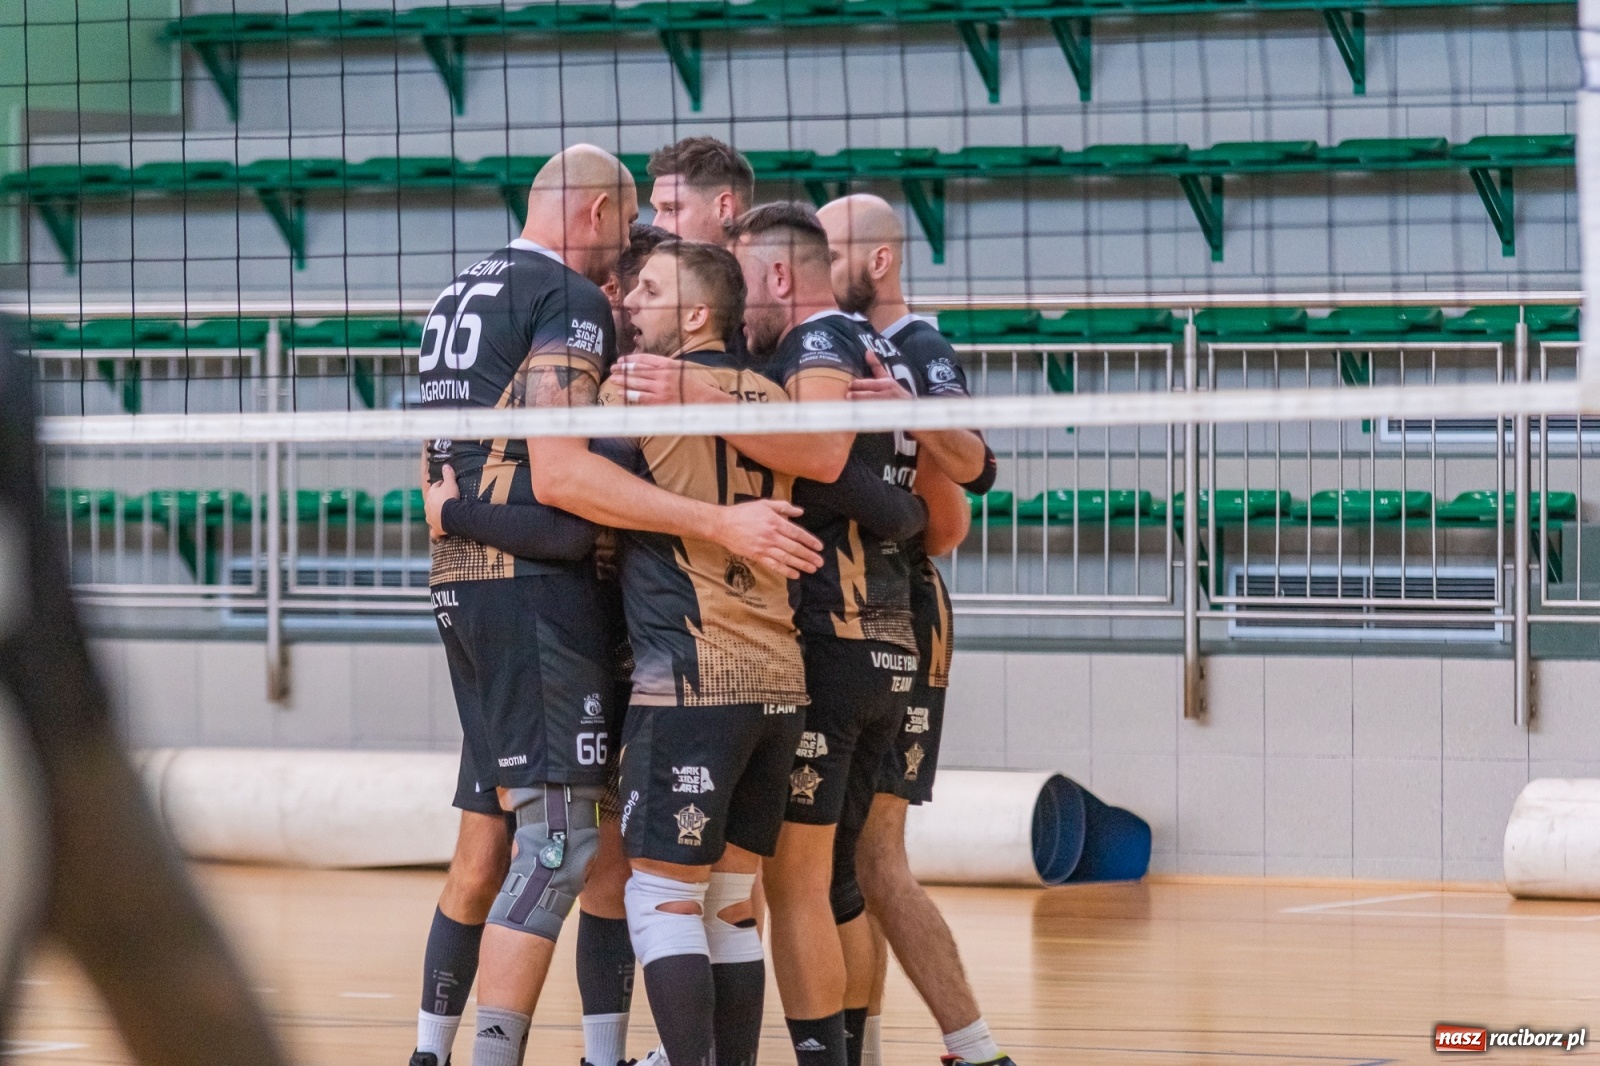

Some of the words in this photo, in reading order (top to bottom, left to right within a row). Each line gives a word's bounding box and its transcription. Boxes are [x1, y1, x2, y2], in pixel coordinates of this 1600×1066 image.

[419, 282, 504, 373] 66
[571, 318, 598, 334] DARK
[574, 328, 597, 344] SIDE
[565, 337, 592, 352] CARS
[421, 379, 470, 404] AGROTIM
[576, 732, 609, 766] 66
[799, 740, 817, 750] IDE
[672, 766, 700, 776] DARK
[677, 775, 701, 785] SIDE
[433, 968, 460, 1016] enji
